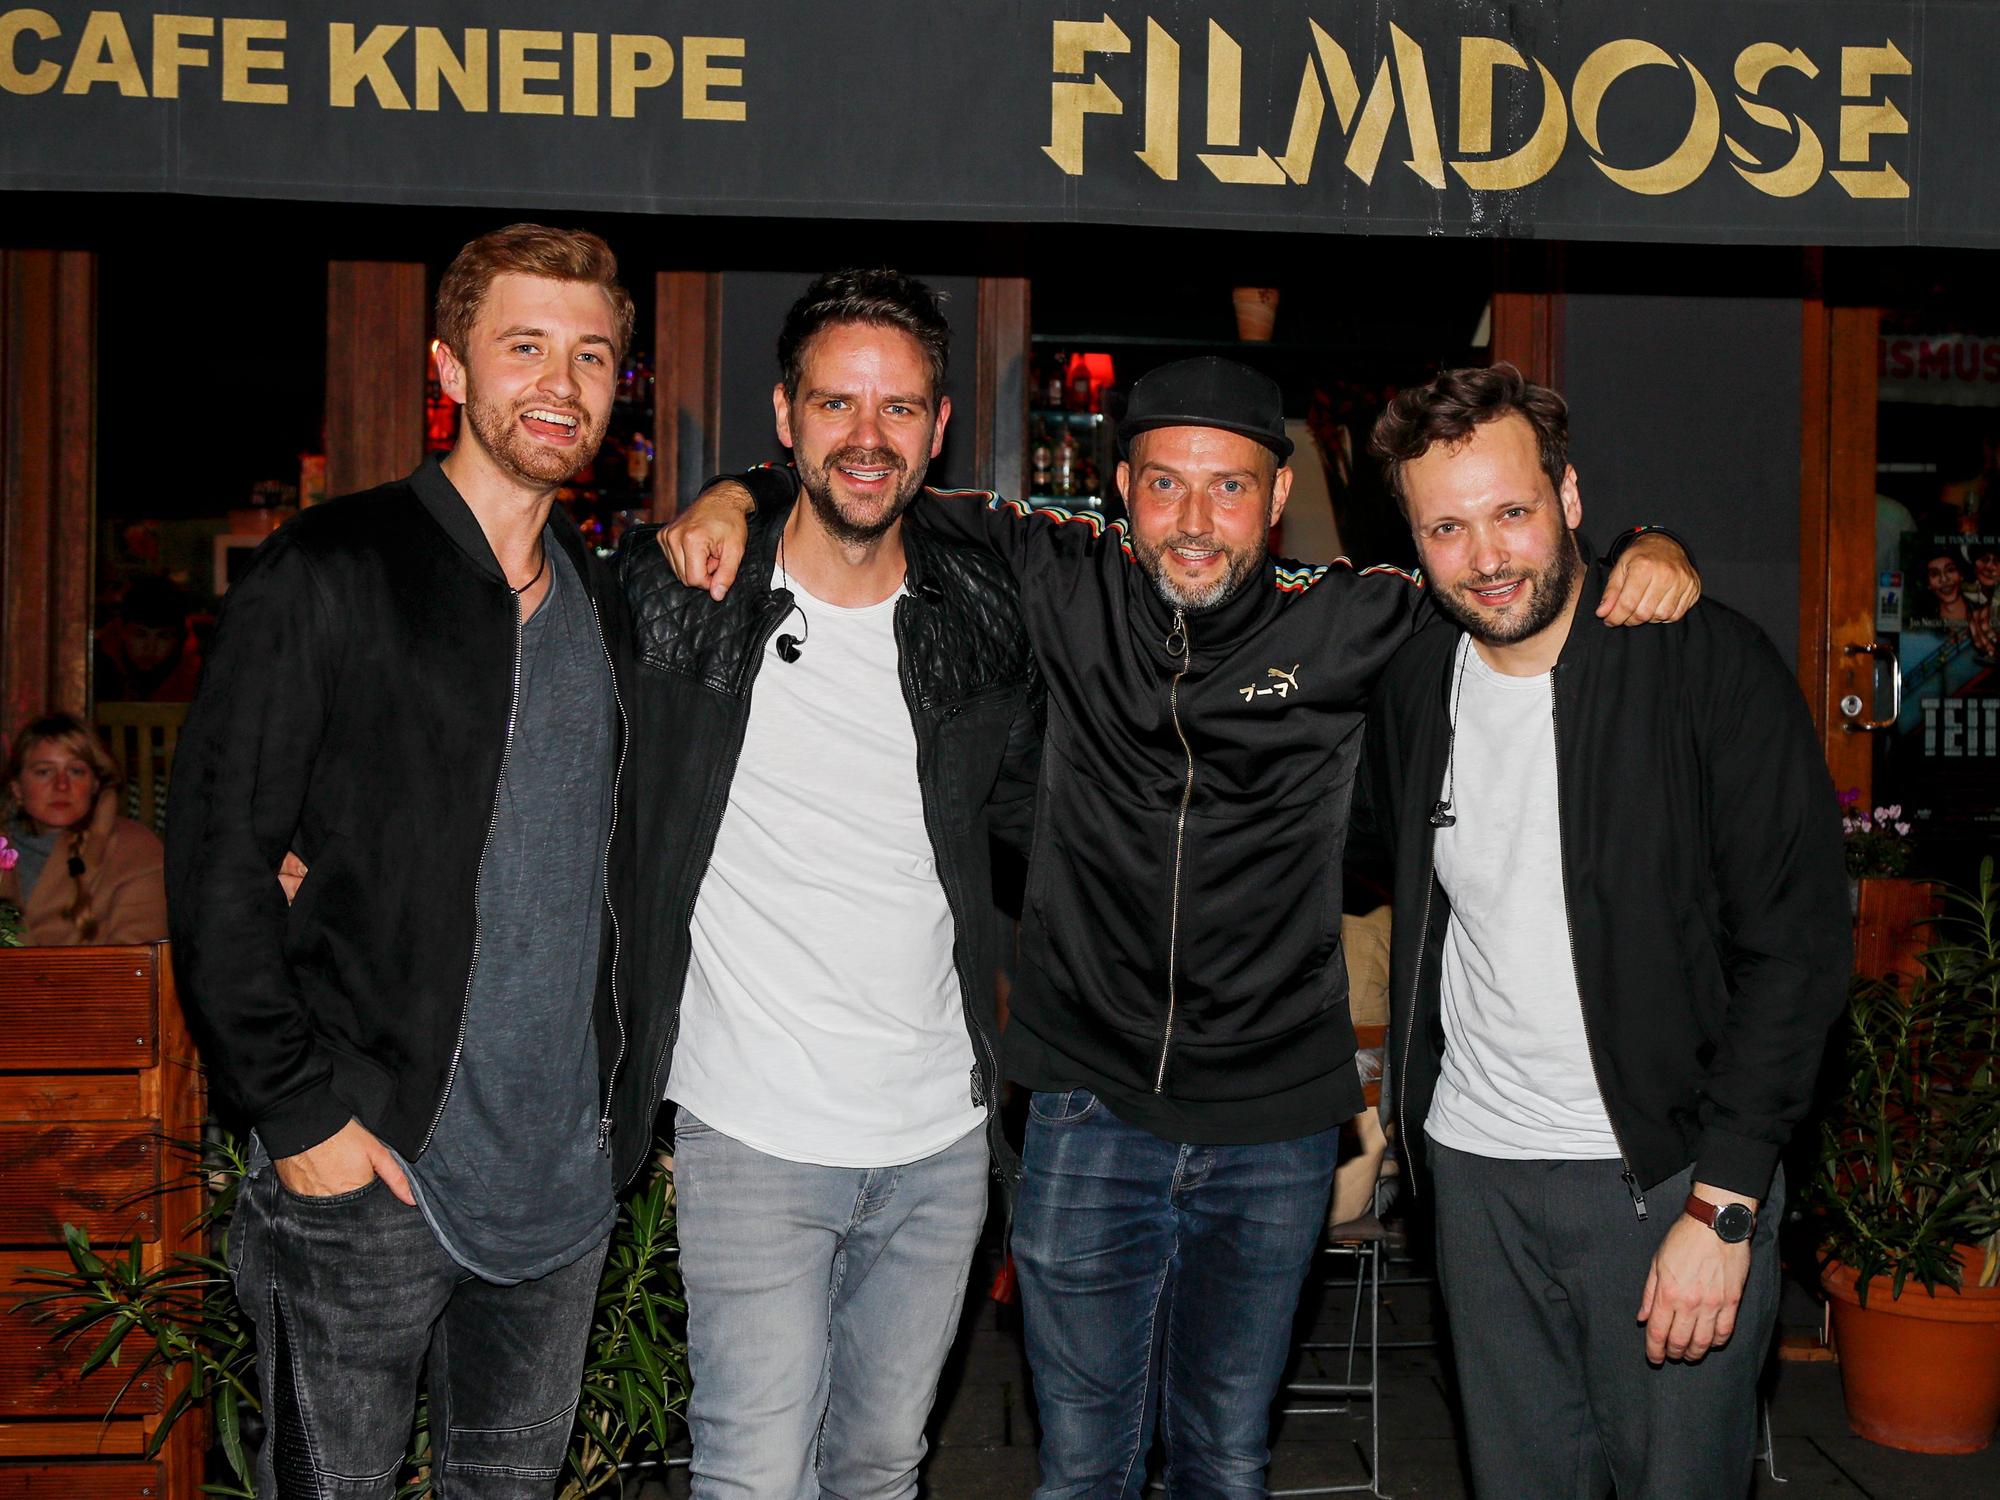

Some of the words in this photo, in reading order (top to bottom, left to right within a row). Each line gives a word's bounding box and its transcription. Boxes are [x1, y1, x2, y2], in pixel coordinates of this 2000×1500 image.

[0, 8, 289, 105] CAFE
[329, 22, 747, 121] KNEIPE
[1041, 12, 1912, 198] FILMDOSE
